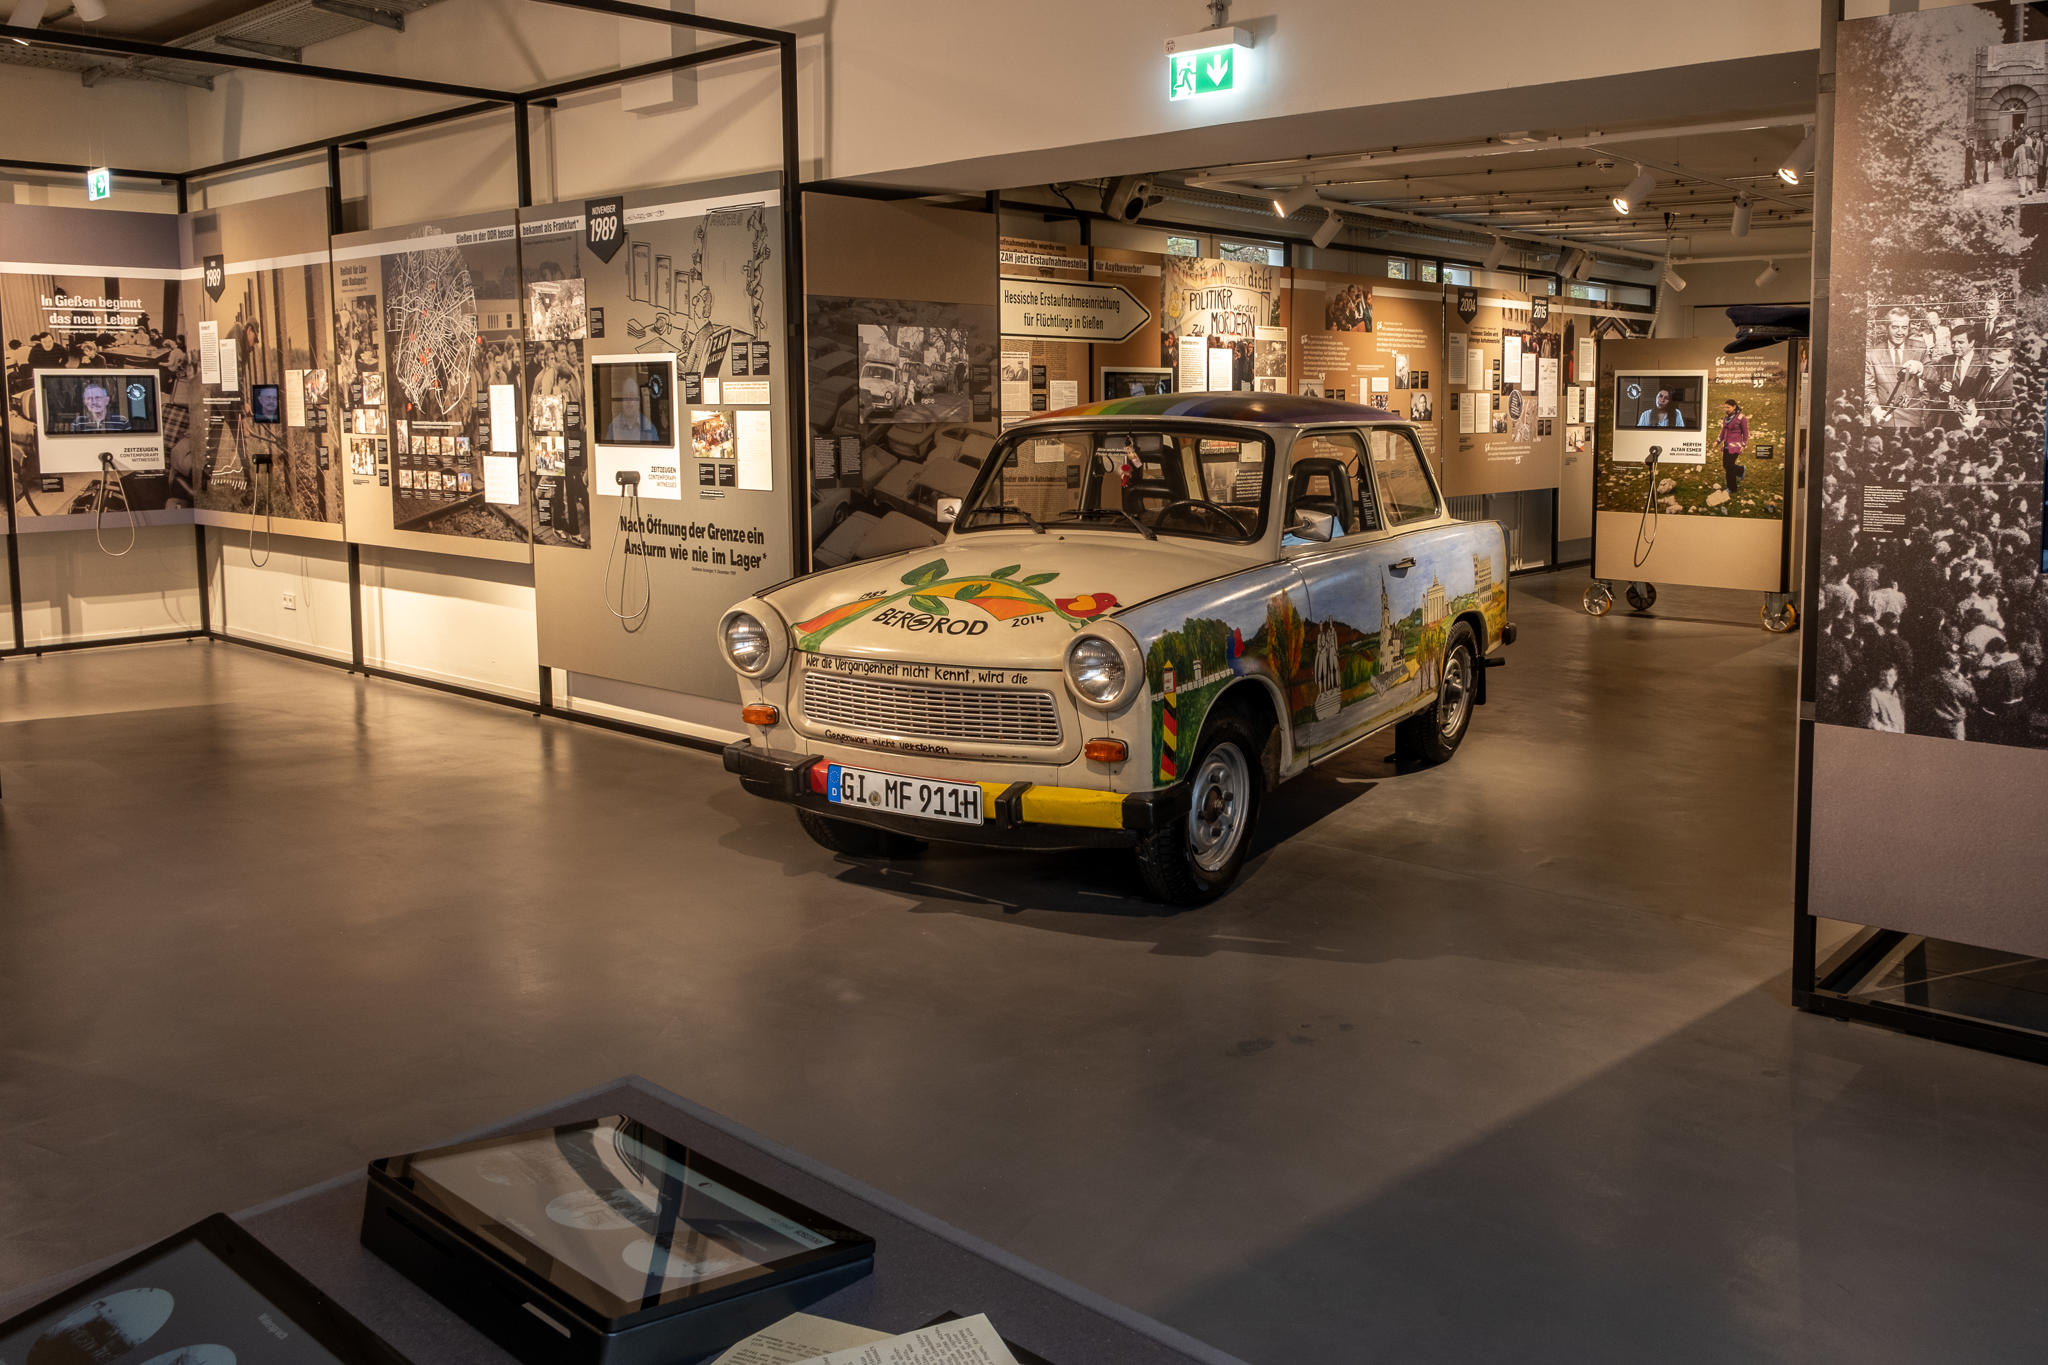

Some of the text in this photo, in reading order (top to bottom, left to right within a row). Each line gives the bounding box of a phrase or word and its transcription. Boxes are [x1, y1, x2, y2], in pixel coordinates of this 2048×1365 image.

[591, 204, 616, 216] NOVEMBER
[497, 228, 514, 239] besser
[522, 224, 544, 236] bekannt
[544, 222, 552, 233] als
[590, 216, 618, 242] 1989
[1000, 252, 1087, 270] ZAH jetzt Erstaufnahmestelle
[1095, 261, 1104, 271] für
[206, 268, 221, 287] 1989
[1226, 273, 1247, 286] macht
[1248, 265, 1273, 290] dicht
[41, 294, 143, 310] In Gießen beginnt
[1004, 289, 1121, 314] Hessische Erstaufnahmeeinrichtung
[1189, 288, 1258, 313] POLITIKER werden
[49, 312, 71, 324] das
[73, 315, 102, 324] neue
[1533, 305, 1547, 319] 2015
[1023, 312, 1104, 331] für Flüchtlinge in Gießen
[648, 473, 677, 481] CONTEMPORARY
[620, 513, 765, 545] Nach Öffnung der Grenze ein
[624, 538, 667, 558] Ansturm
[669, 544, 688, 560] wie
[691, 545, 709, 563] nie
[712, 547, 726, 565] im
[1011, 615, 1045, 628] 2014
[805, 653, 819, 667] Wer
[821, 656, 832, 669] die
[835, 658, 899, 676] Vergangenheit
[902, 664, 930, 679] nicht
[978, 670, 1005, 684] wird
[1011, 672, 1028, 684] die
[824, 729, 950, 754] Gegenwart nicht verstehen
[831, 787, 838, 796] D
[841, 772, 979, 820] GI MF 911H
